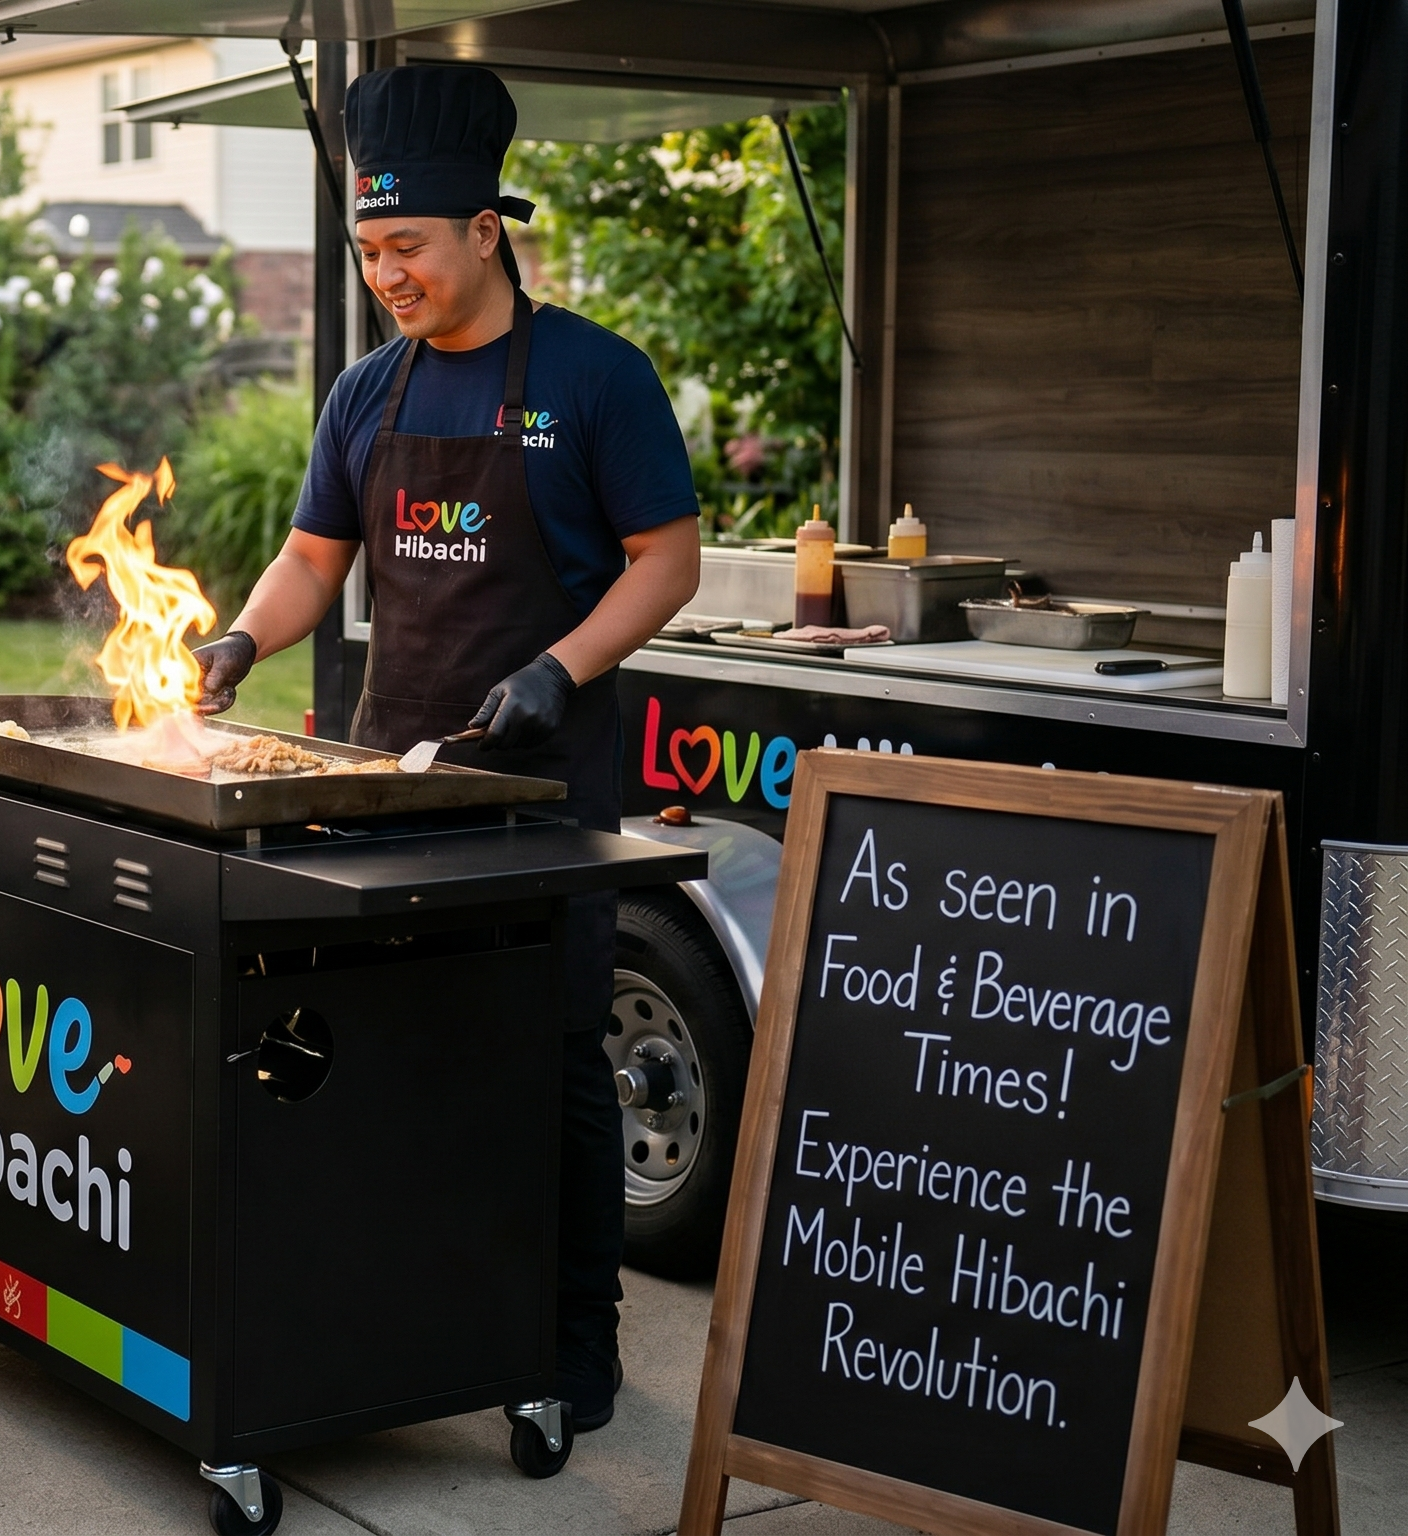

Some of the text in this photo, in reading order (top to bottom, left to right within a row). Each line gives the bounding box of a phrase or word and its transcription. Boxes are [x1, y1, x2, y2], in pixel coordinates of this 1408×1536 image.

[395, 534, 487, 562] Hibachi
[396, 488, 486, 534] Love
[643, 696, 797, 809] Love
[839, 828, 1137, 942] As seen in
[819, 934, 1171, 1072] Food & Beverage
[903, 1031, 1074, 1120] Times!
[796, 1109, 1132, 1238] Experience the
[783, 1204, 1125, 1340] Mobile Hibachi
[821, 1302, 1067, 1429] Revolution.
